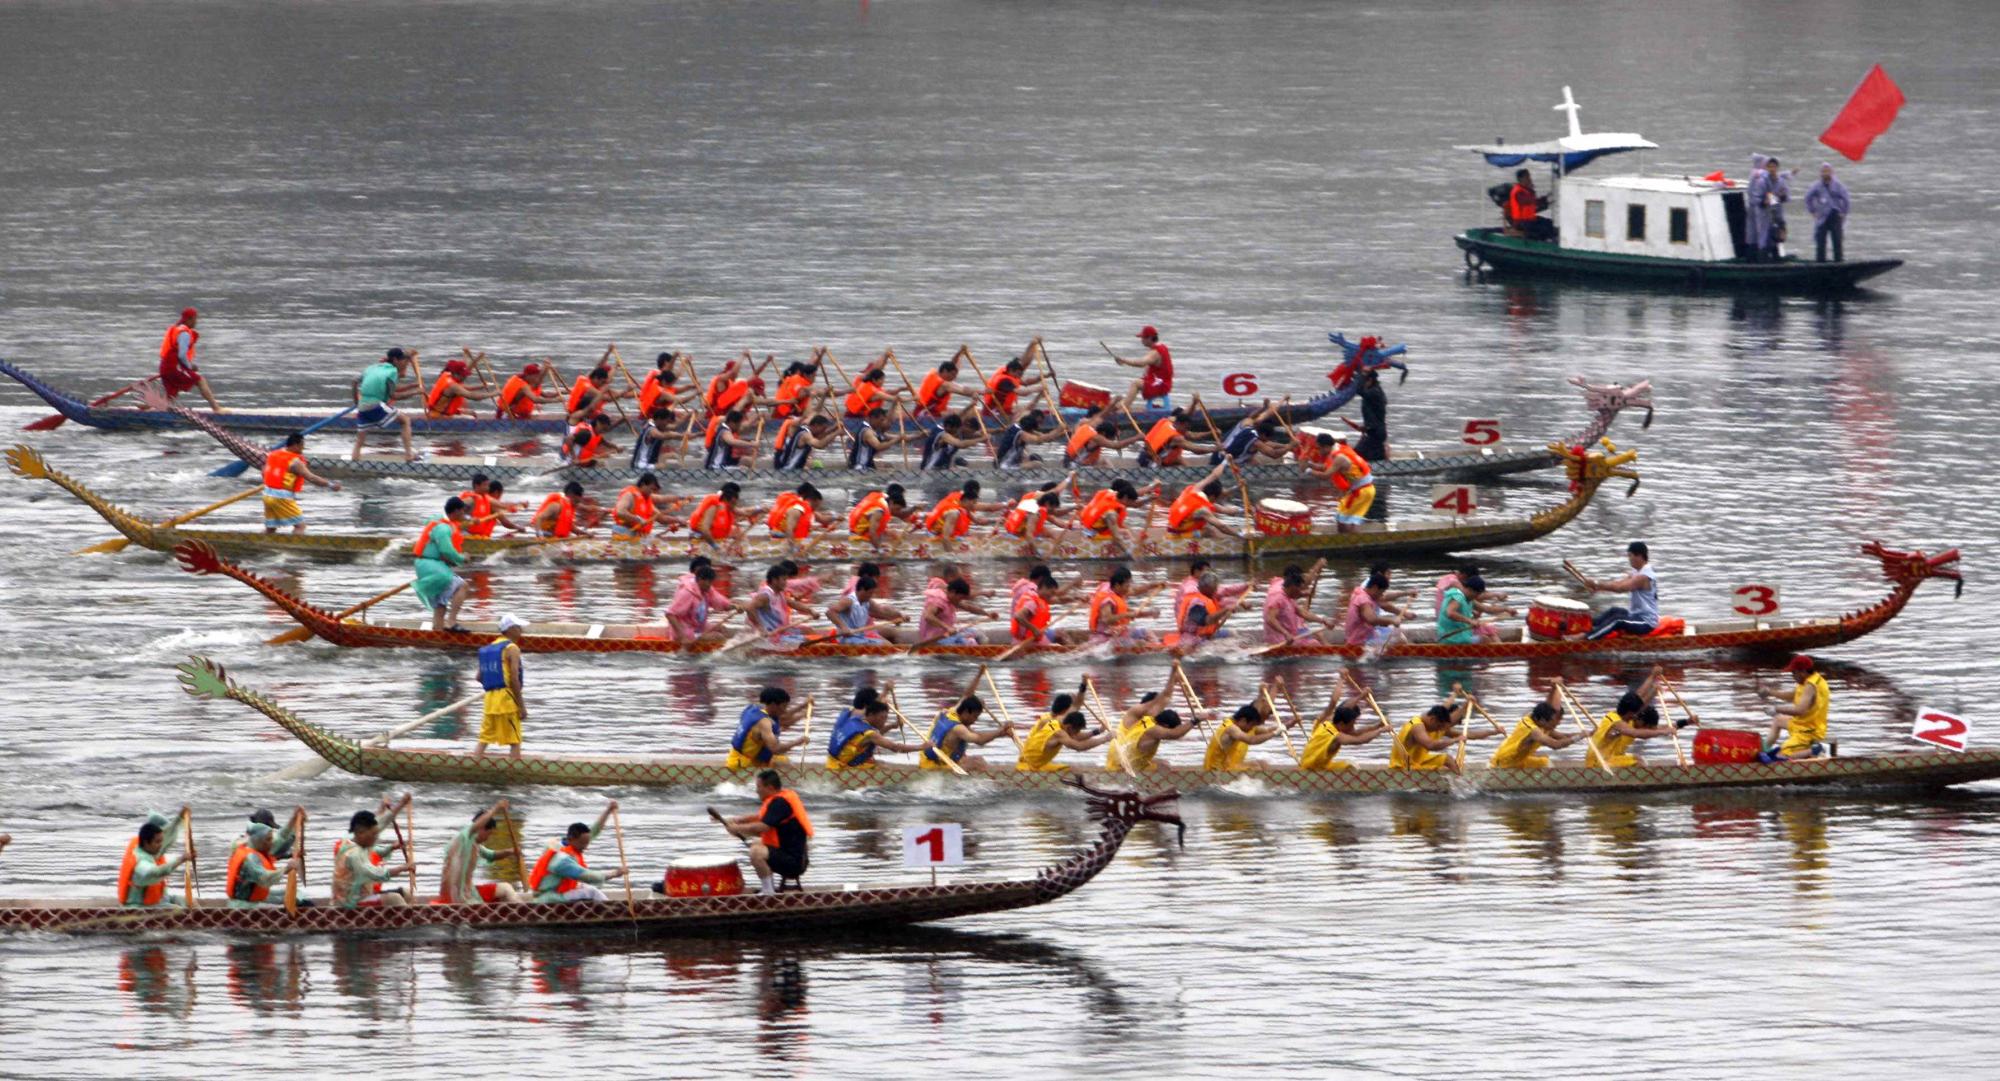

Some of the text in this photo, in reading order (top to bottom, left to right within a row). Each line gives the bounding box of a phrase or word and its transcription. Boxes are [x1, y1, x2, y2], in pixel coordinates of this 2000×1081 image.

[1223, 373, 1258, 396] 6
[1463, 420, 1500, 445] 5
[1433, 487, 1477, 515] 4
[1734, 584, 1779, 616] 3
[1915, 713, 1968, 750] 2
[915, 827, 945, 863] 1
